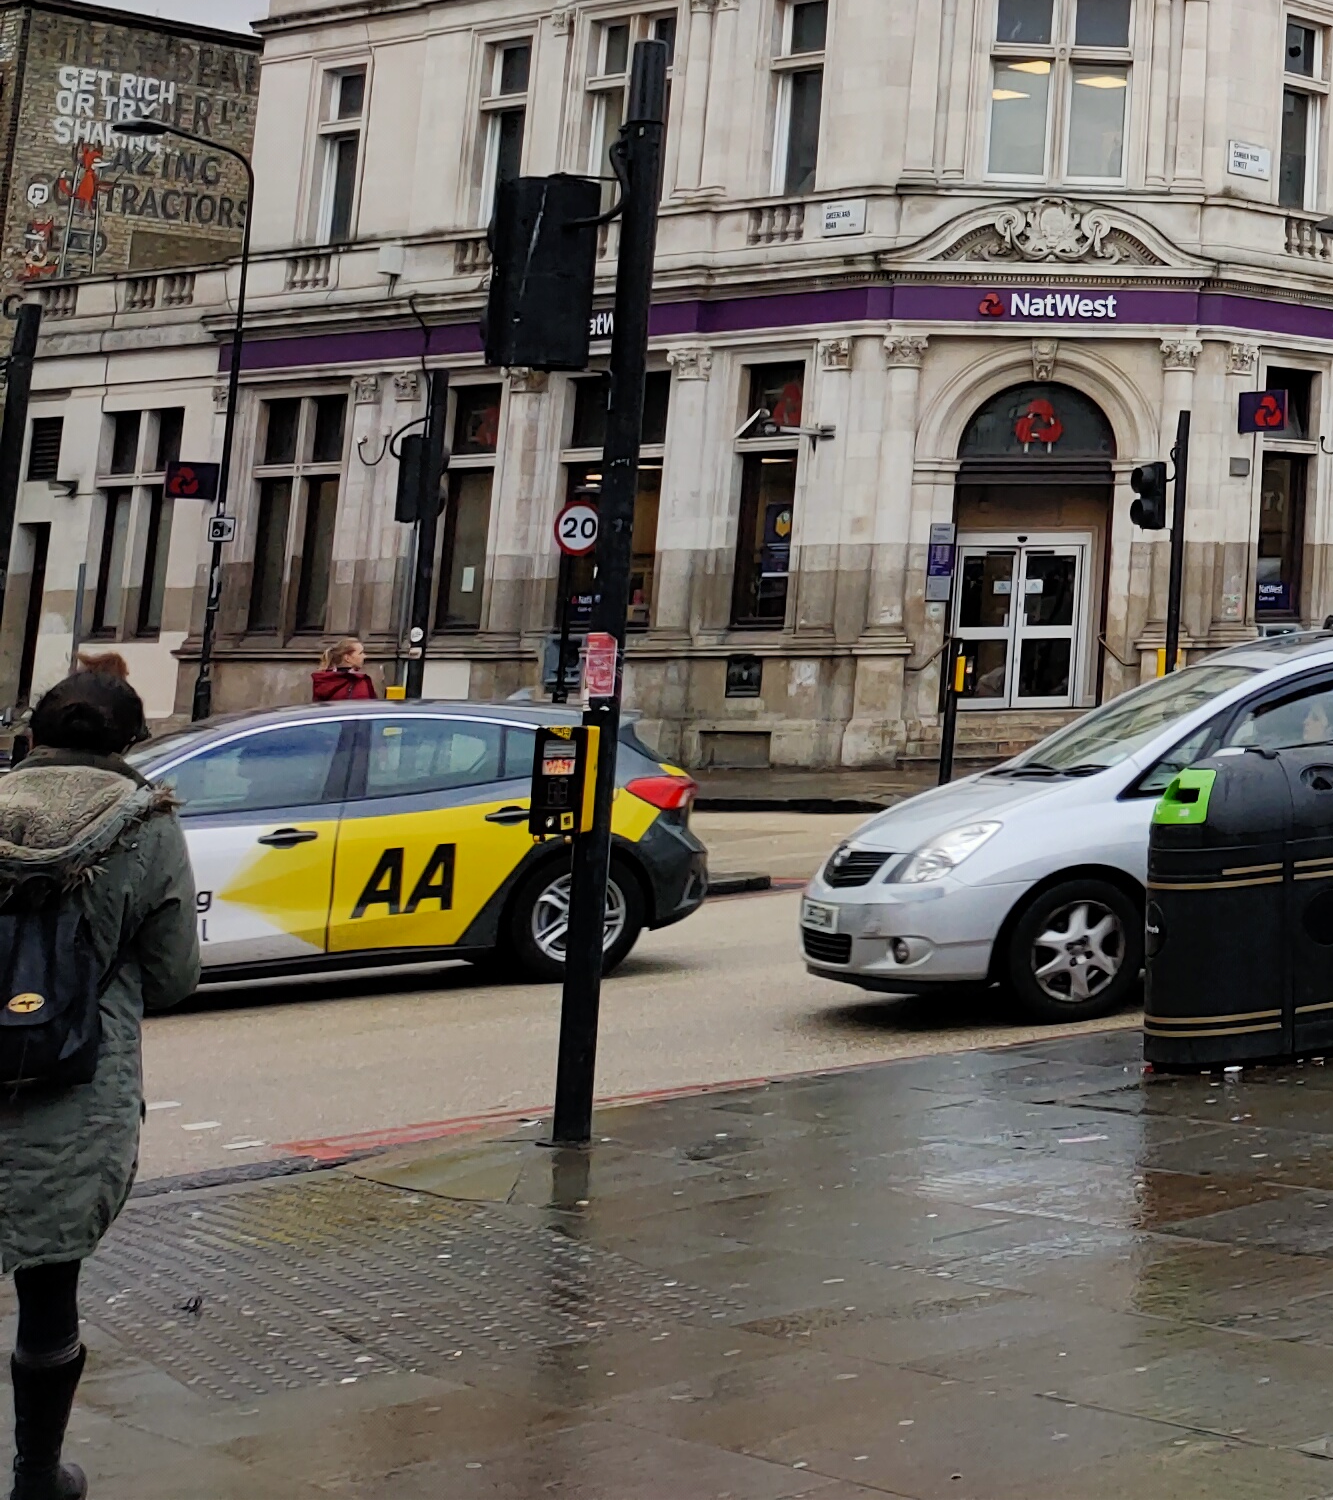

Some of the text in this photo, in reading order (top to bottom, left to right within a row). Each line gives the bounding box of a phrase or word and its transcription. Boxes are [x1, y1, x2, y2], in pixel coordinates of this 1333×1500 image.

[58, 65, 175, 104] GET RICH
[55, 90, 95, 117] OR
[101, 95, 158, 121] TRY
[826, 210, 850, 220] GREENLAND
[1010, 292, 1117, 318] NatWest
[562, 517, 597, 539] 20
[1259, 584, 1283, 594] NatWest
[349, 843, 457, 920] AA
